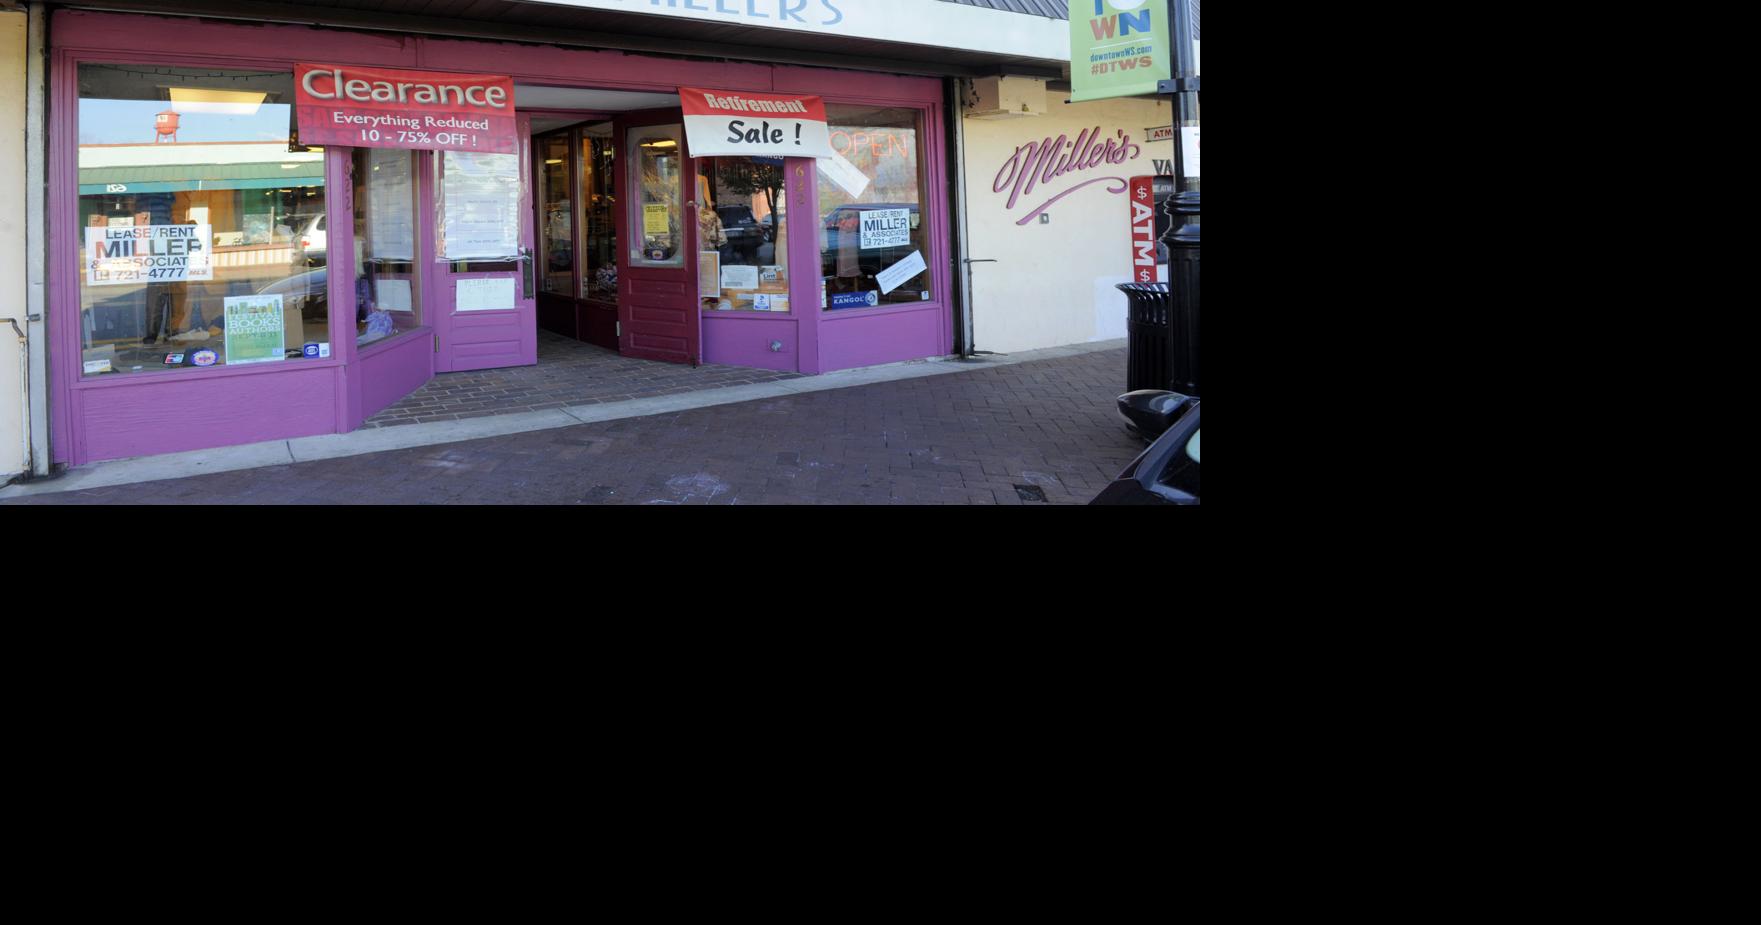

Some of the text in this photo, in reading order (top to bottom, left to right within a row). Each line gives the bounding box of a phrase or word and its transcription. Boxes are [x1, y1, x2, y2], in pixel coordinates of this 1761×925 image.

[1089, 9, 1151, 41] WN
[1090, 46, 1152, 62] downtownWS.com
[1091, 56, 1152, 75] #DTWS
[302, 69, 506, 108] Clearance
[703, 93, 808, 113] Retirement
[333, 112, 420, 129] Everything
[425, 116, 489, 130] Reduced
[361, 129, 380, 141] 10
[396, 131, 431, 144] 75%
[435, 133, 468, 145] OFF
[727, 120, 802, 146] Sale !
[1153, 128, 1173, 138] ATM
[829, 130, 908, 158] OPEN
[993, 126, 1140, 209] Miller's
[105, 227, 196, 239] LEASE/RENT
[864, 218, 907, 232] MILLER
[1132, 201, 1154, 266] ATM
[116, 268, 185, 280] 721-4777
[229, 318, 280, 329] BOOKS
